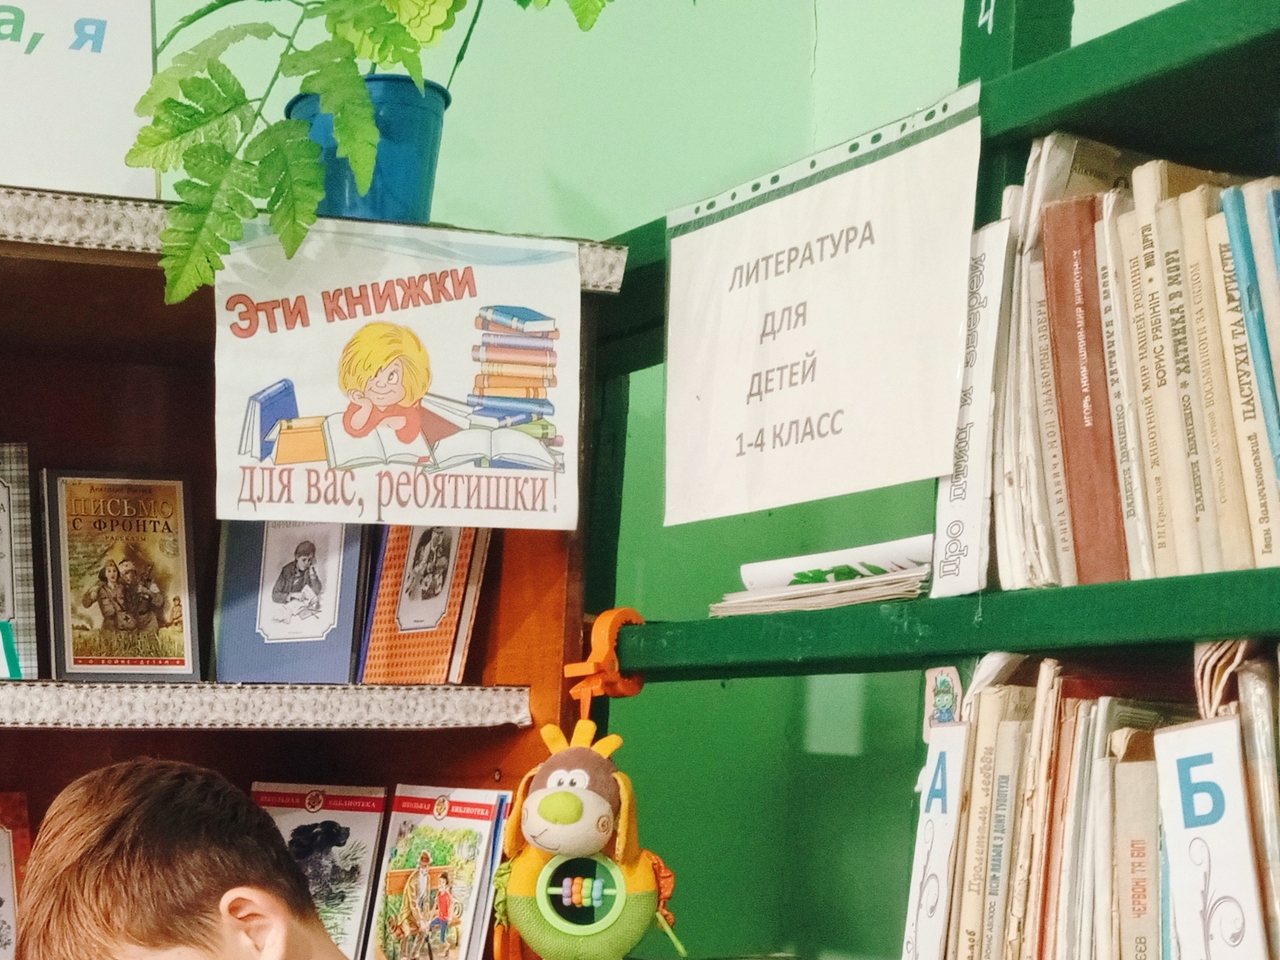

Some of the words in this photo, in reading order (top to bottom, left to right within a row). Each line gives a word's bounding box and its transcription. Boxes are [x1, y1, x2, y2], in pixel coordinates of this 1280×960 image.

[67, 17, 106, 53] я
[729, 220, 875, 292] ЛИТЕРАТУРА
[1219, 242, 1243, 314] АРТИСТИ
[225, 293, 309, 339] Эти
[321, 266, 477, 323] книжки
[1129, 256, 1144, 311] РОДИНЫ
[760, 301, 808, 345] ДЛЯ
[1133, 313, 1148, 362] НАШЕЙ
[1148, 291, 1163, 341] РЯБІНІН
[1170, 304, 1191, 376] ХАТИНКА
[1195, 308, 1205, 324] ЗА
[1231, 321, 1246, 340] ТА
[746, 351, 818, 404] ДЕТЕЙ
[1039, 344, 1053, 415] ЗНАКОМЫЕ
[1140, 366, 1151, 393] МИР
[1153, 344, 1167, 388] БОРИС
[1197, 328, 1215, 409] ВОСЬМИНОГИ
[1233, 342, 1257, 422] ПАСТУХИ
[735, 427, 766, 457] 1-4
[772, 409, 845, 449] КЛАСС
[1143, 395, 1160, 470] ЖИВОТНЫЙ
[69, 498, 174, 519] ПИСЬМО
[305, 468, 364, 516] вас,
[376, 463, 558, 521] ребятишки!
[72, 518, 82, 531] С
[92, 518, 173, 533] ФРОНТА
[939, 520, 968, 578] Про
[924, 750, 948, 815] А
[1175, 753, 1226, 830] Б
[450, 806, 489, 816] БИБЛИОТЕКА
[1132, 878, 1147, 919] ЧЕРВОНІ
